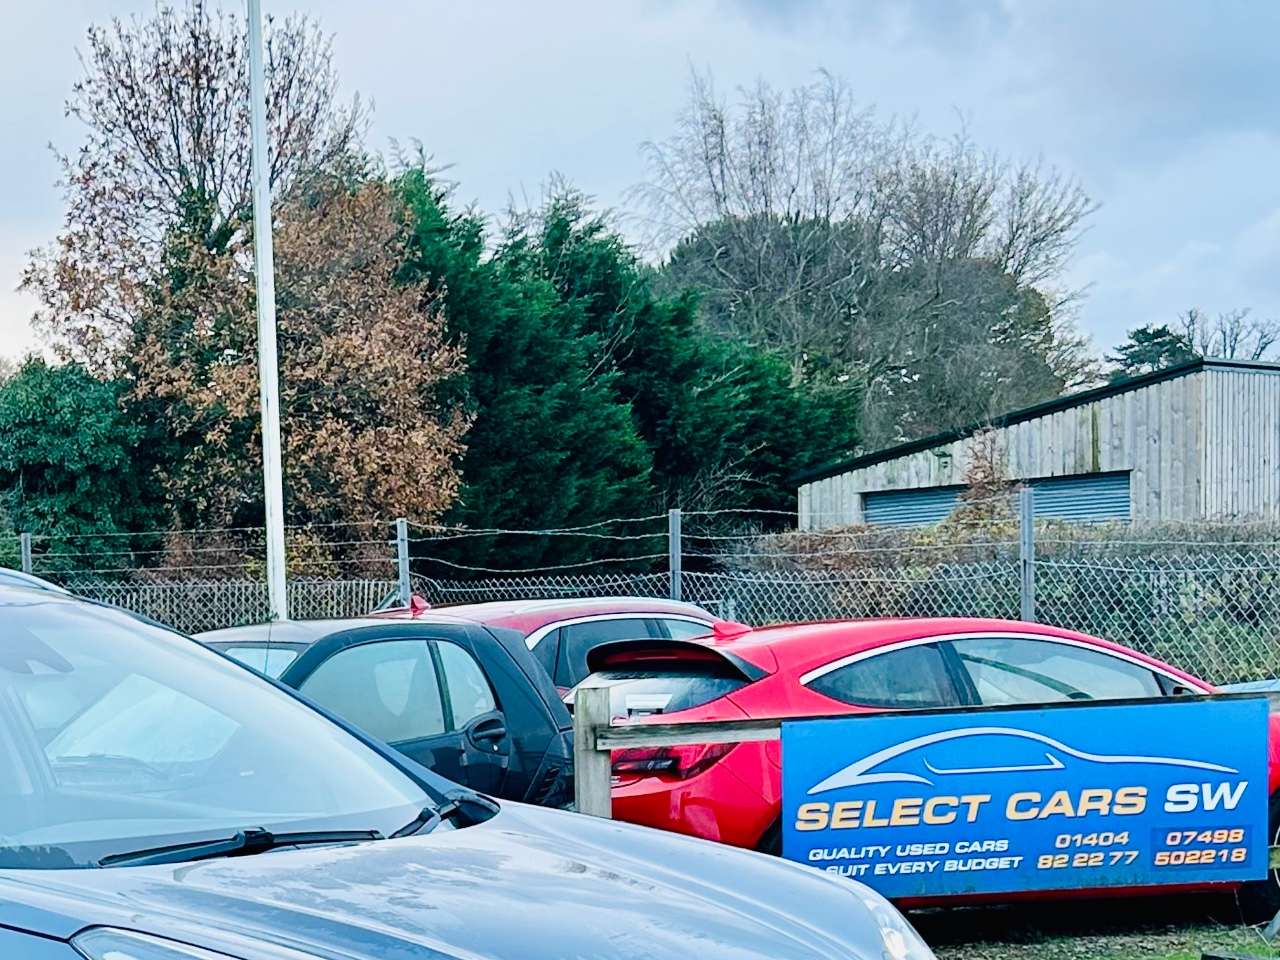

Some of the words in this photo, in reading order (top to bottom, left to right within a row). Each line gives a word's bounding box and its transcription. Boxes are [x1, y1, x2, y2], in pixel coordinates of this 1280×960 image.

[795, 794, 991, 831] SELECT
[1005, 786, 1148, 821] CARS
[1164, 781, 1248, 813] SW
[1055, 831, 1130, 848] 01404
[1166, 829, 1245, 846] 07498
[808, 845, 891, 861] QUALITY
[896, 842, 949, 857] USED
[955, 840, 1009, 854] CARS
[1154, 848, 1247, 866] 502218
[826, 863, 870, 877] SUIT
[874, 860, 940, 876] EVERY
[944, 857, 1023, 872] BUDGET
[1037, 853, 1068, 869] 82
[1072, 852, 1104, 868] 22
[1109, 851, 1139, 866] 77
